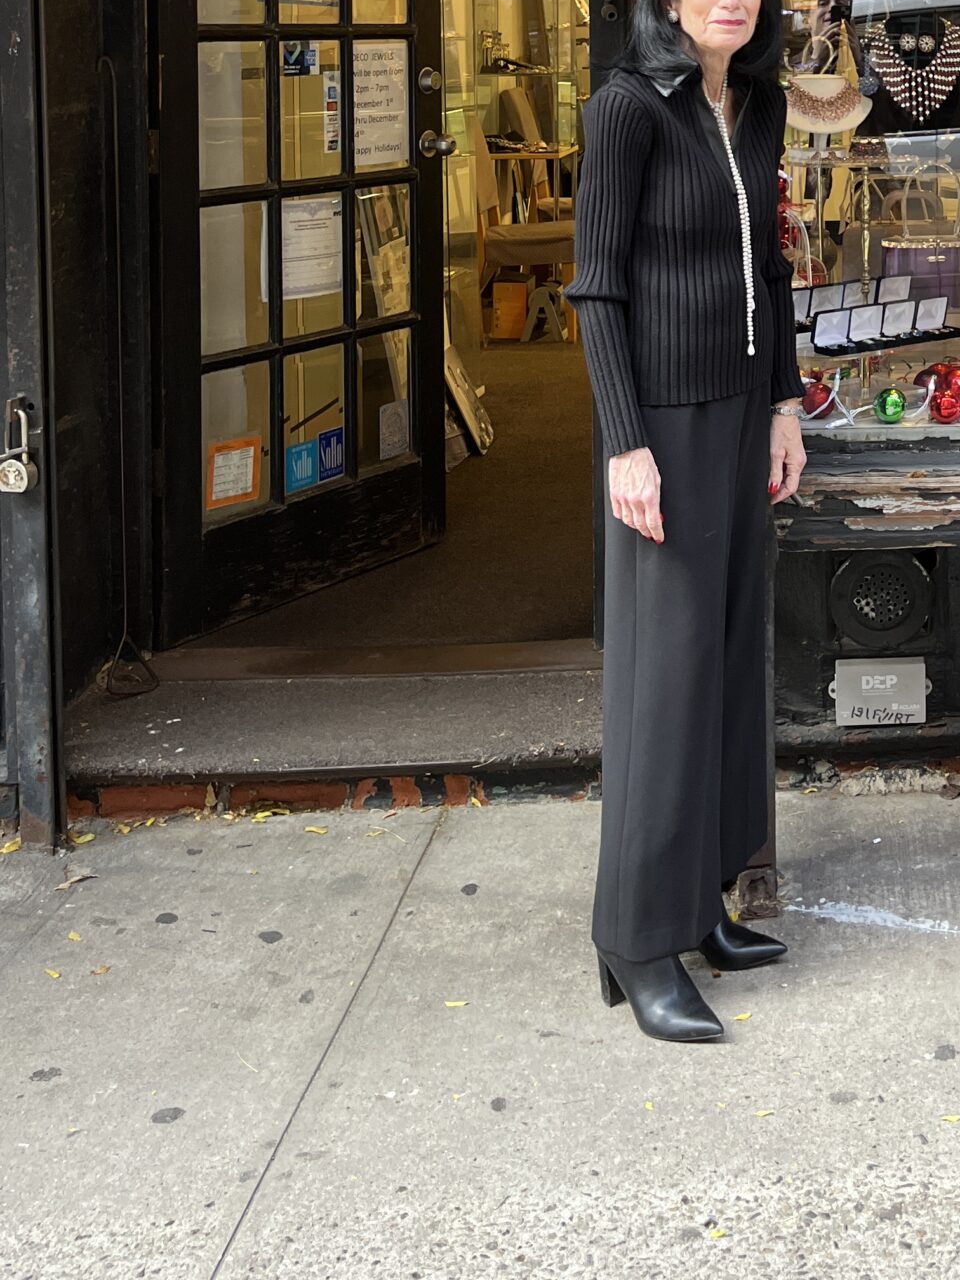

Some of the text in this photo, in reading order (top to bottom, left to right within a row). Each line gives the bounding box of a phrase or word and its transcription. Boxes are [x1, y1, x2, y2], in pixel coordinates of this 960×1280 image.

[354, 100, 383, 109] ecember
[355, 147, 371, 156] appy
[320, 436, 342, 471] SoHo
[861, 675, 897, 689] DEP
